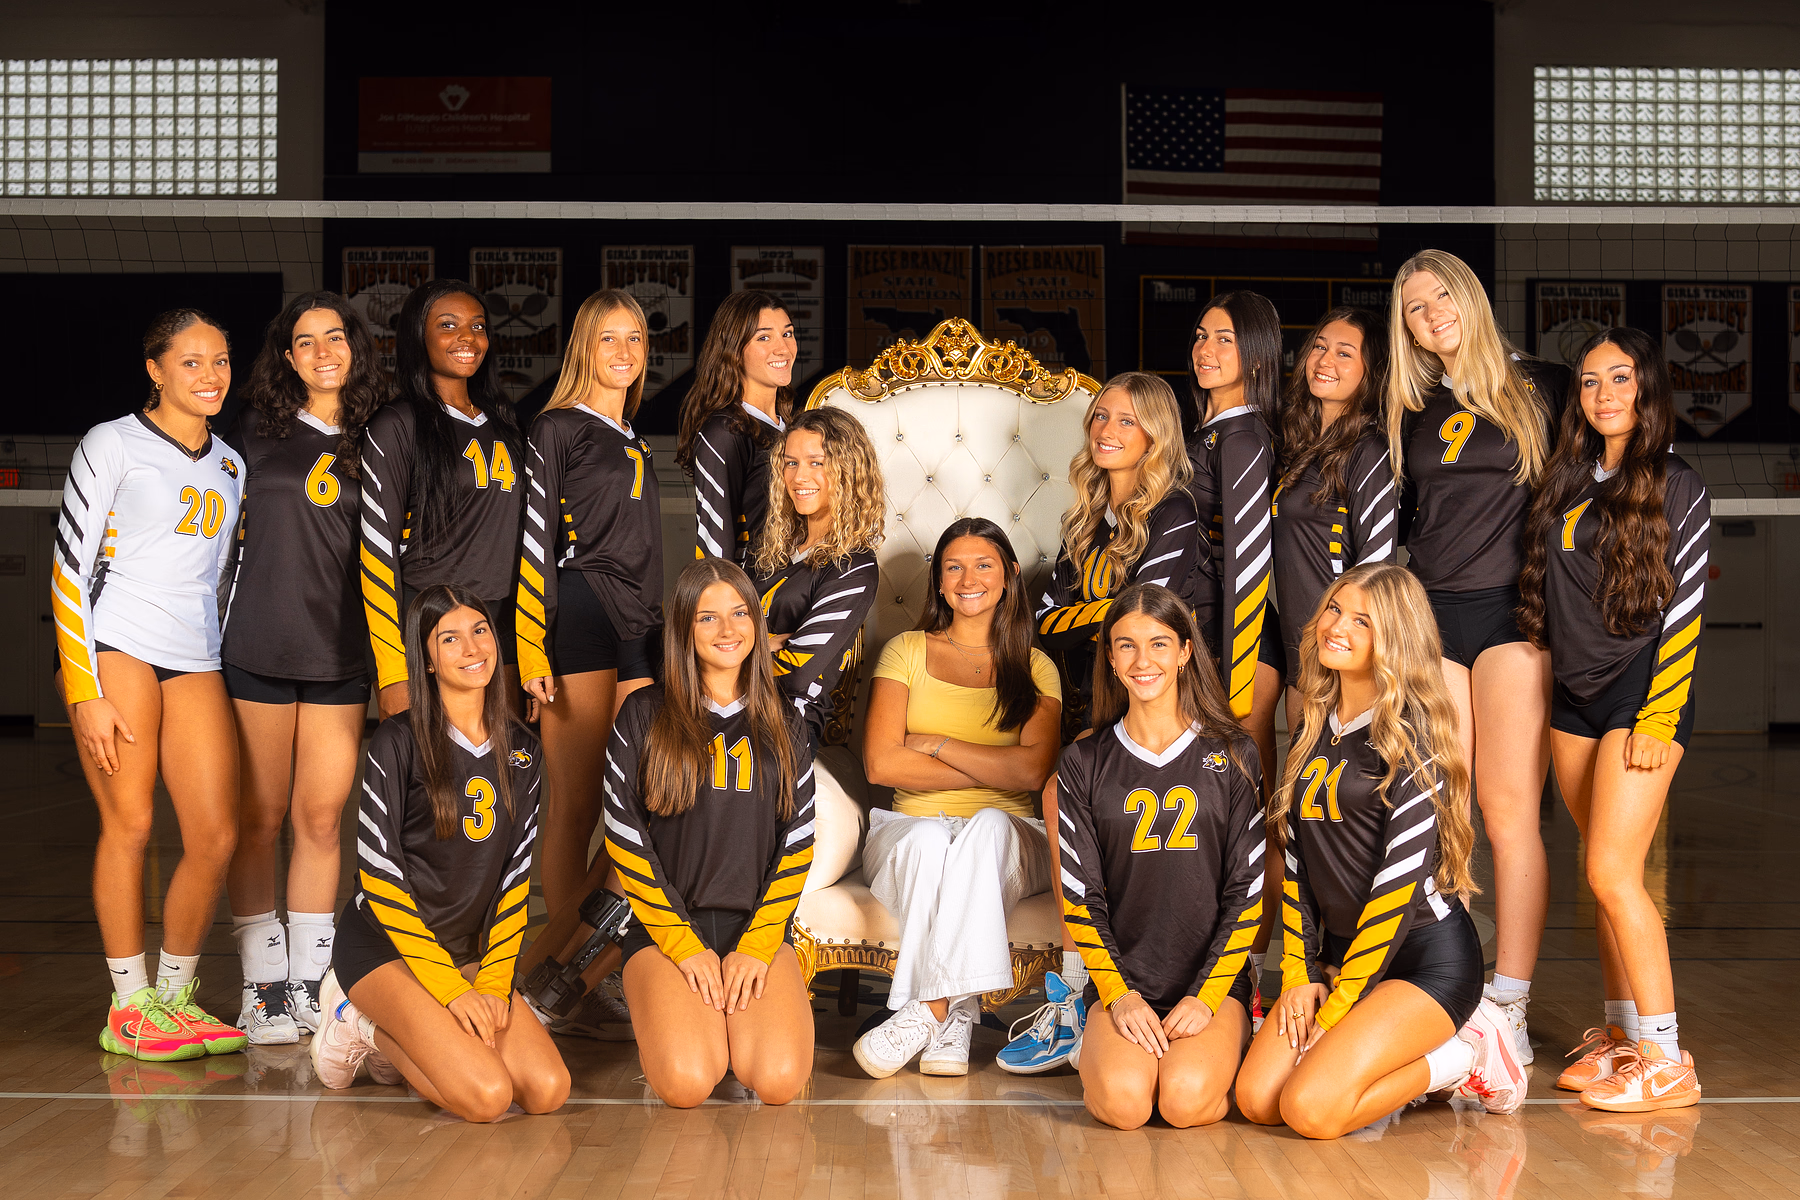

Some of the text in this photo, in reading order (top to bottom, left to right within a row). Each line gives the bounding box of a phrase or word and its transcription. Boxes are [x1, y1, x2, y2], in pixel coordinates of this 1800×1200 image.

[377, 113, 531, 123] Joe DiMaggio Children's Hospital
[431, 124, 460, 134] Sports
[462, 124, 503, 133] Medicine
[347, 251, 429, 261] GIRLS BOWLING
[475, 252, 557, 262] GIRLS TENNIS
[606, 250, 689, 260] GIRLS BOWLING
[761, 251, 793, 259] 2022
[854, 251, 966, 280] REESE BRANZIL
[987, 251, 1099, 279] REESE BRANZIL
[348, 263, 429, 299] DISTRICT
[476, 264, 557, 296] DISTRICT
[607, 262, 690, 295] DISTRICT
[882, 276, 938, 287] STATE
[990, 288, 1096, 299] CHAMPION
[1015, 276, 1072, 287] STATE
[1153, 281, 1197, 302] Home
[1541, 287, 1620, 297] GIRLS VOLLEYBALL
[1667, 288, 1747, 299] GIRLS TENNIS
[858, 289, 963, 300] CHAMPION
[1541, 299, 1620, 334] DISTRICT
[1667, 301, 1747, 335] DISTRICT
[493, 323, 558, 355] AMPIONS
[500, 357, 532, 368] 2010
[1668, 360, 1747, 392] CHAMPIONS
[1692, 393, 1722, 405] 2007
[1439, 411, 1476, 464] 9
[305, 452, 341, 507] 6
[463, 438, 516, 492] 14
[624, 446, 644, 500] 7
[174, 485, 226, 539] 20
[1562, 498, 1593, 551] 1
[706, 732, 753, 792] 11
[1300, 756, 1348, 822] 21
[463, 776, 497, 842] 3
[1124, 785, 1198, 853] 22
